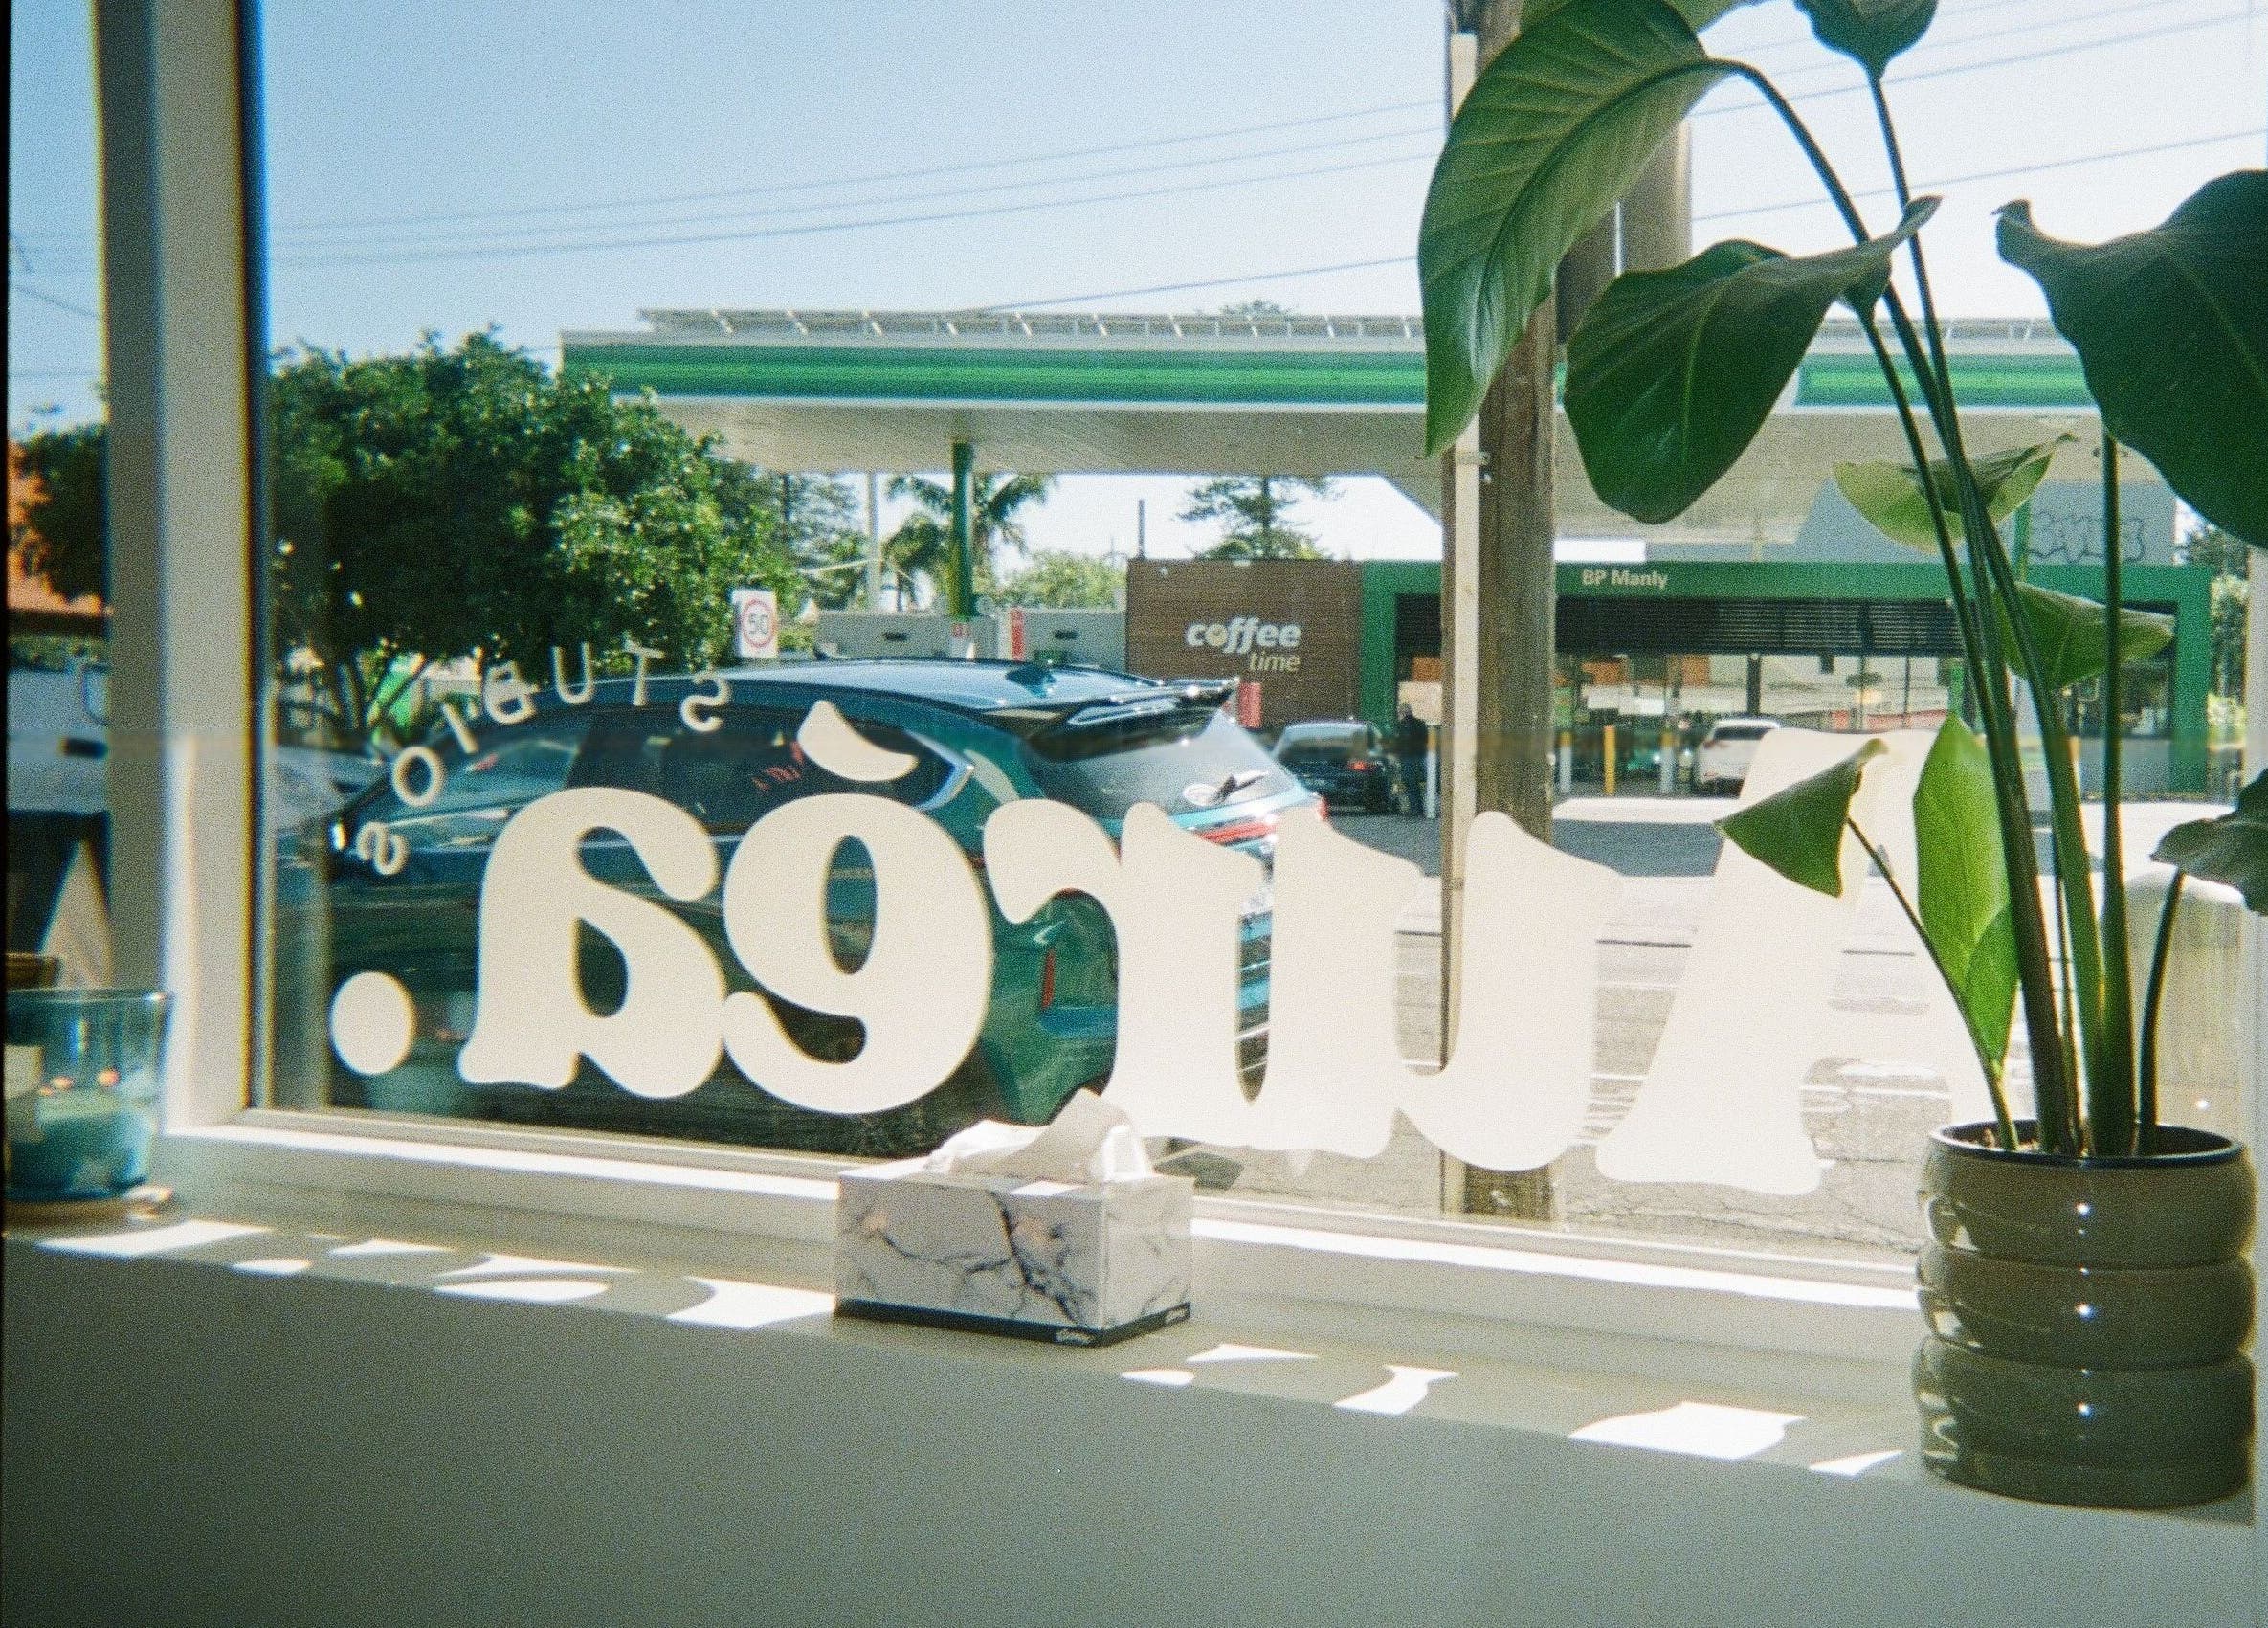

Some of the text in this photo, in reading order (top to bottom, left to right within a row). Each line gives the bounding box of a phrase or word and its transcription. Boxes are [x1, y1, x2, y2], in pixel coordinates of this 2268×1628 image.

[1582, 569, 1668, 590] BP Manly
[1185, 615, 1302, 654] coffee
[1250, 652, 1301, 672] time
